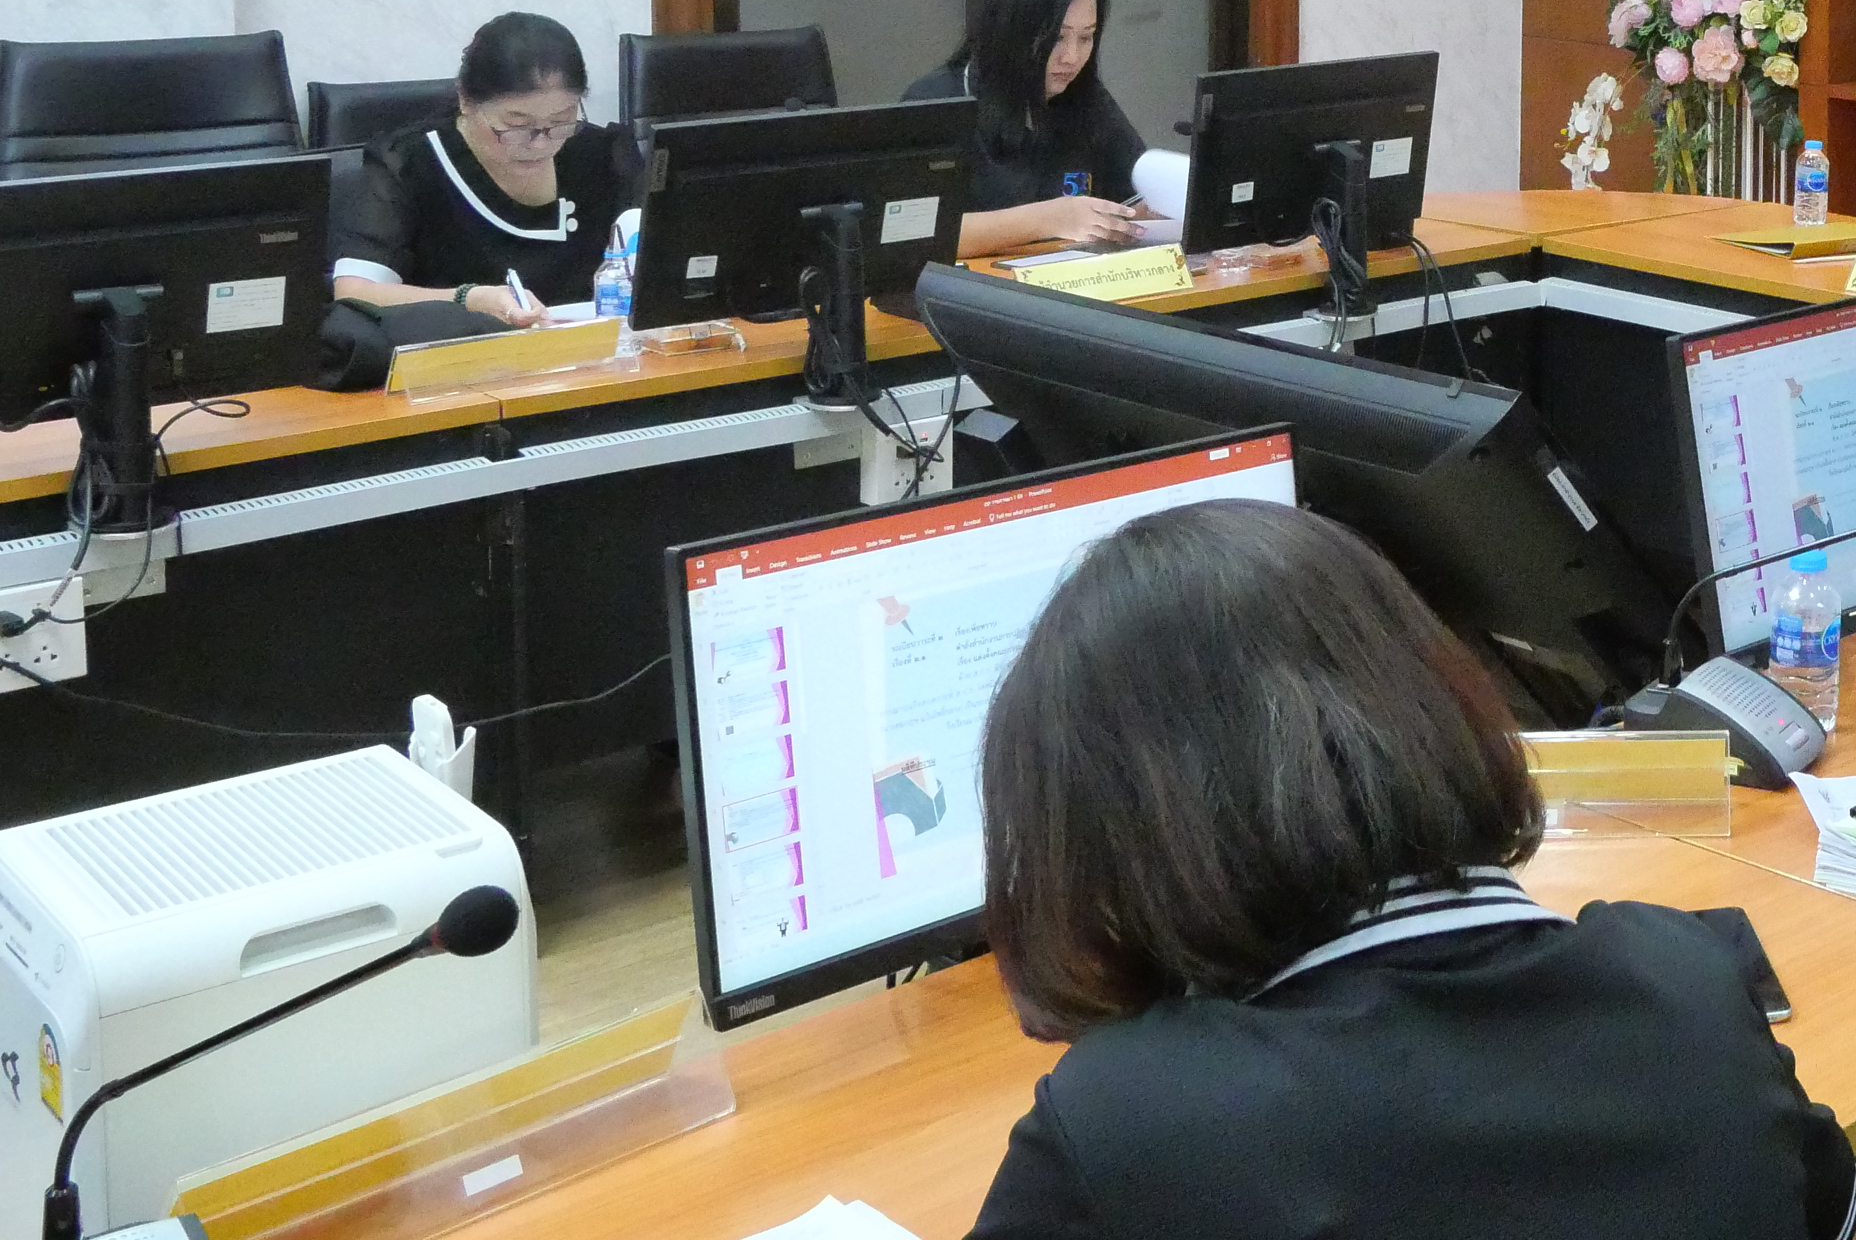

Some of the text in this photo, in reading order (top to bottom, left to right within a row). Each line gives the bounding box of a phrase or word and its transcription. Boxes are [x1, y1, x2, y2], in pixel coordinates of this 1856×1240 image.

[1036, 264, 1173, 291] ้อำนวยการสำนักบริหารกลาง
[726, 994, 776, 1020] ThinkVision
